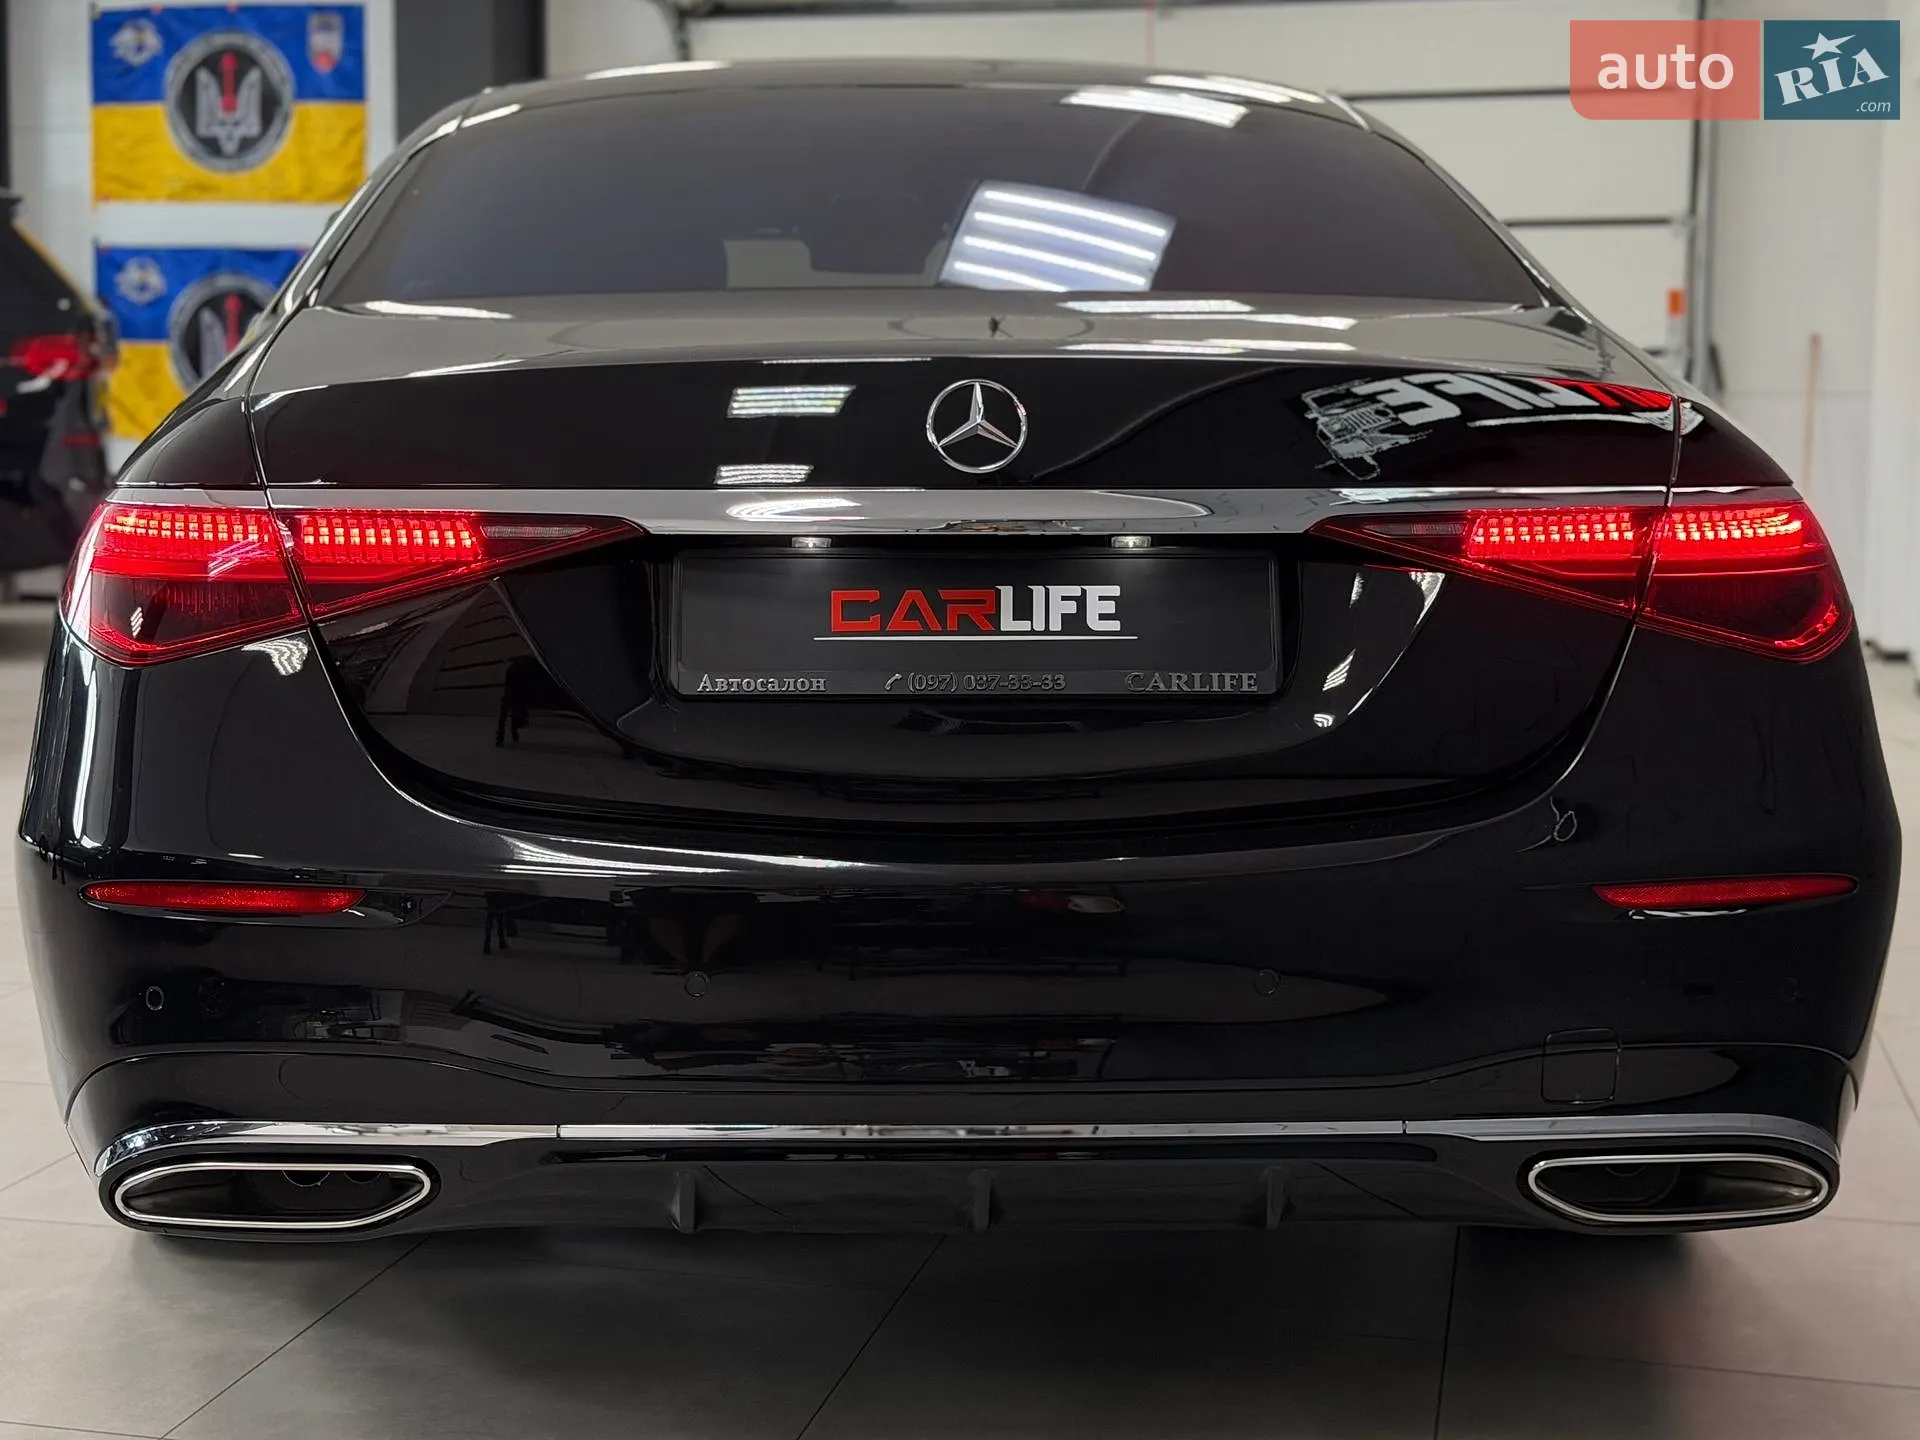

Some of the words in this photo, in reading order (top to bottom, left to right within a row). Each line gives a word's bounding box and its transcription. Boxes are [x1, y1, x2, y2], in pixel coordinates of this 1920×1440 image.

[830, 585, 1121, 633] CARLIFE
[697, 673, 827, 692] Автосалон
[907, 672, 958, 693] (097)
[963, 674, 1066, 691] 037-33-33
[1125, 672, 1258, 692] CARLIFE
